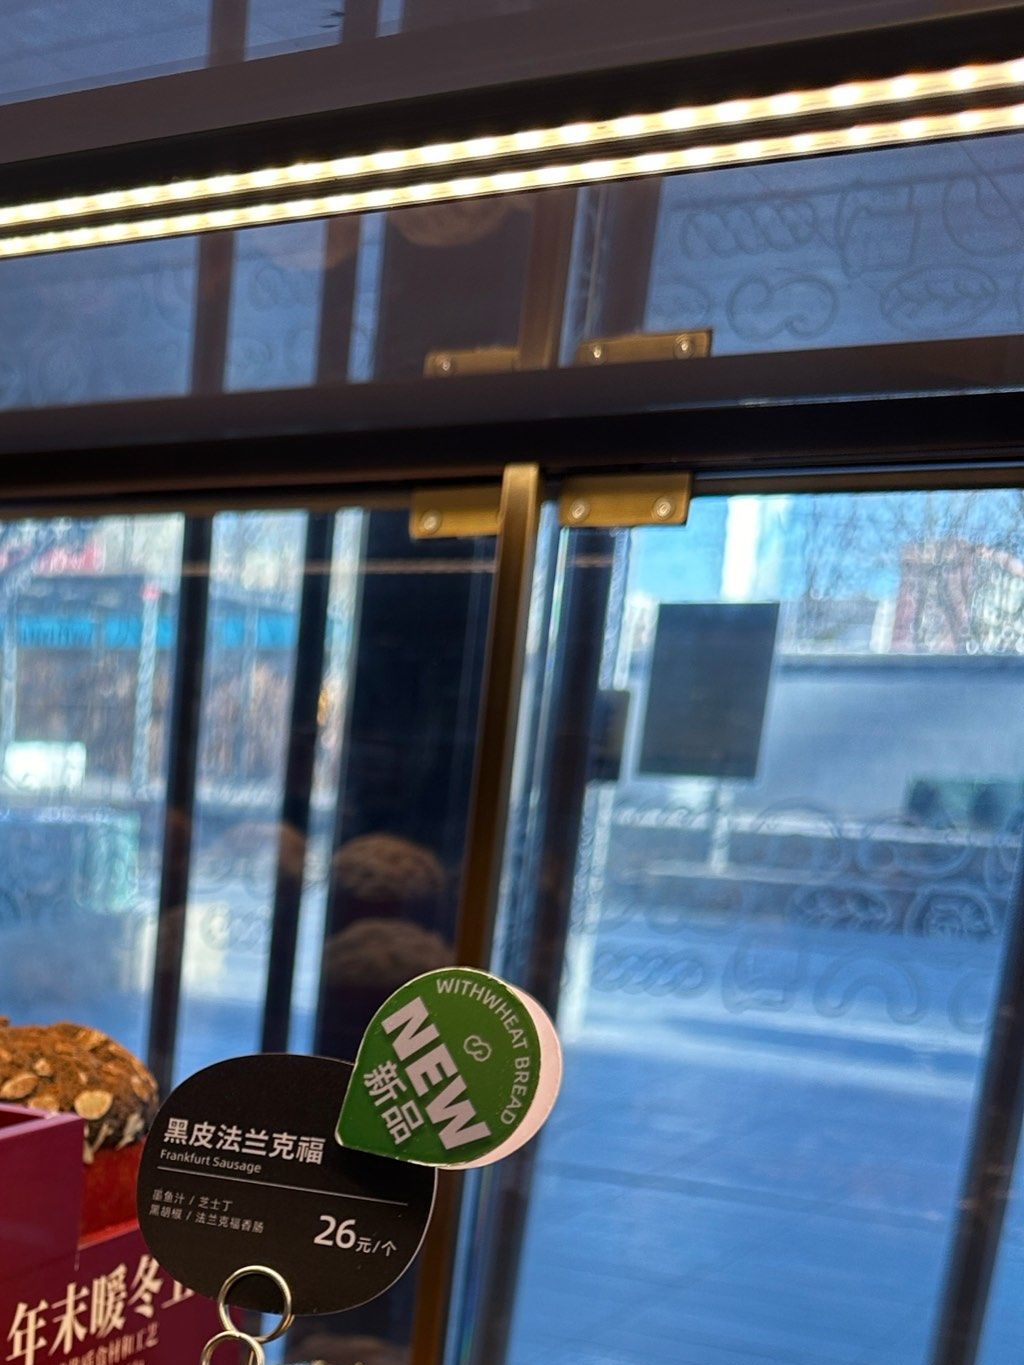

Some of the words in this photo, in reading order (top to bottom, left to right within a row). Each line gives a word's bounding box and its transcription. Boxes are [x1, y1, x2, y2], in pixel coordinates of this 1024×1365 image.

[381, 996, 492, 1150] NEW
[436, 978, 528, 1050] WITHWHEAT
[500, 1056, 530, 1125] BREAD
[363, 1060, 424, 1145] 新品
[160, 1148, 210, 1166] Frankfurt
[212, 1156, 262, 1174] Sausage
[163, 1117, 326, 1165] 黑皮法兰克福
[149, 1204, 183, 1220] 黑胡椒
[195, 1212, 264, 1234] 法兰克福香肠
[314, 1214, 397, 1257] 26元/个
